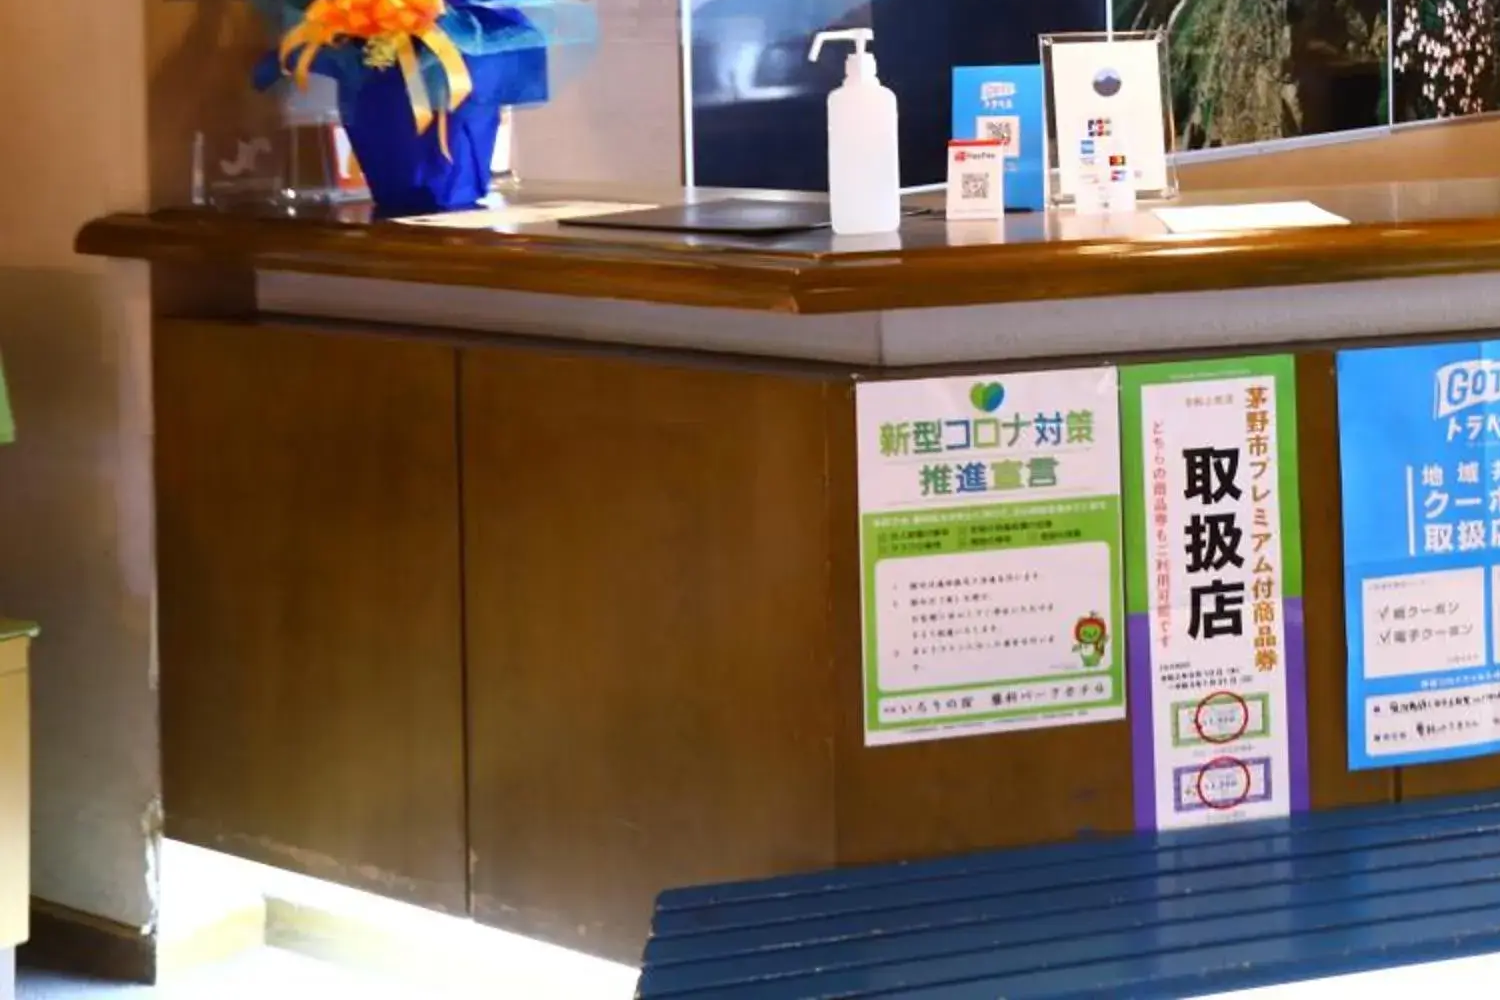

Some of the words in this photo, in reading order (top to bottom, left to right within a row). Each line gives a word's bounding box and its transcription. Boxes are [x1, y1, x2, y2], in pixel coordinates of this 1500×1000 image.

[879, 409, 1094, 457] 新型コロナ対策
[919, 457, 1060, 496] 推進宣言
[1181, 446, 1245, 640] 取扱店
